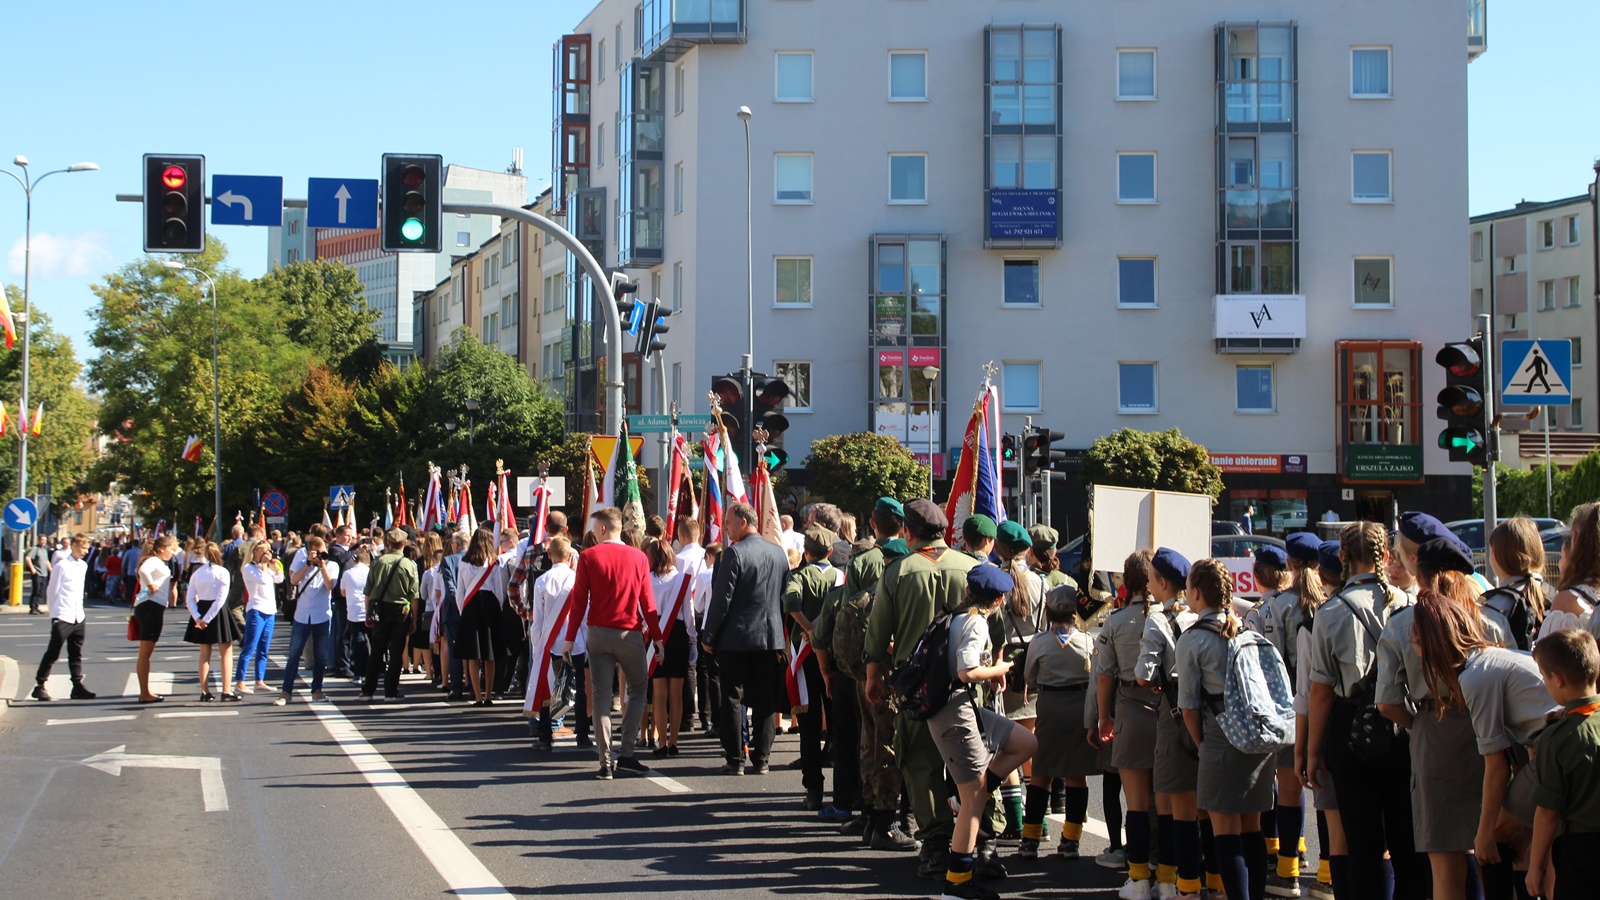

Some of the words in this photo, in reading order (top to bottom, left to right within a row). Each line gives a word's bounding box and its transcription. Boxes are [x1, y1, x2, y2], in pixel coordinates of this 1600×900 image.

[637, 418, 646, 426] ul.
[647, 418, 668, 426] Adama
[1211, 456, 1234, 465] tanie
[1235, 456, 1278, 466] ubieranie
[1345, 490, 1350, 498] 4
